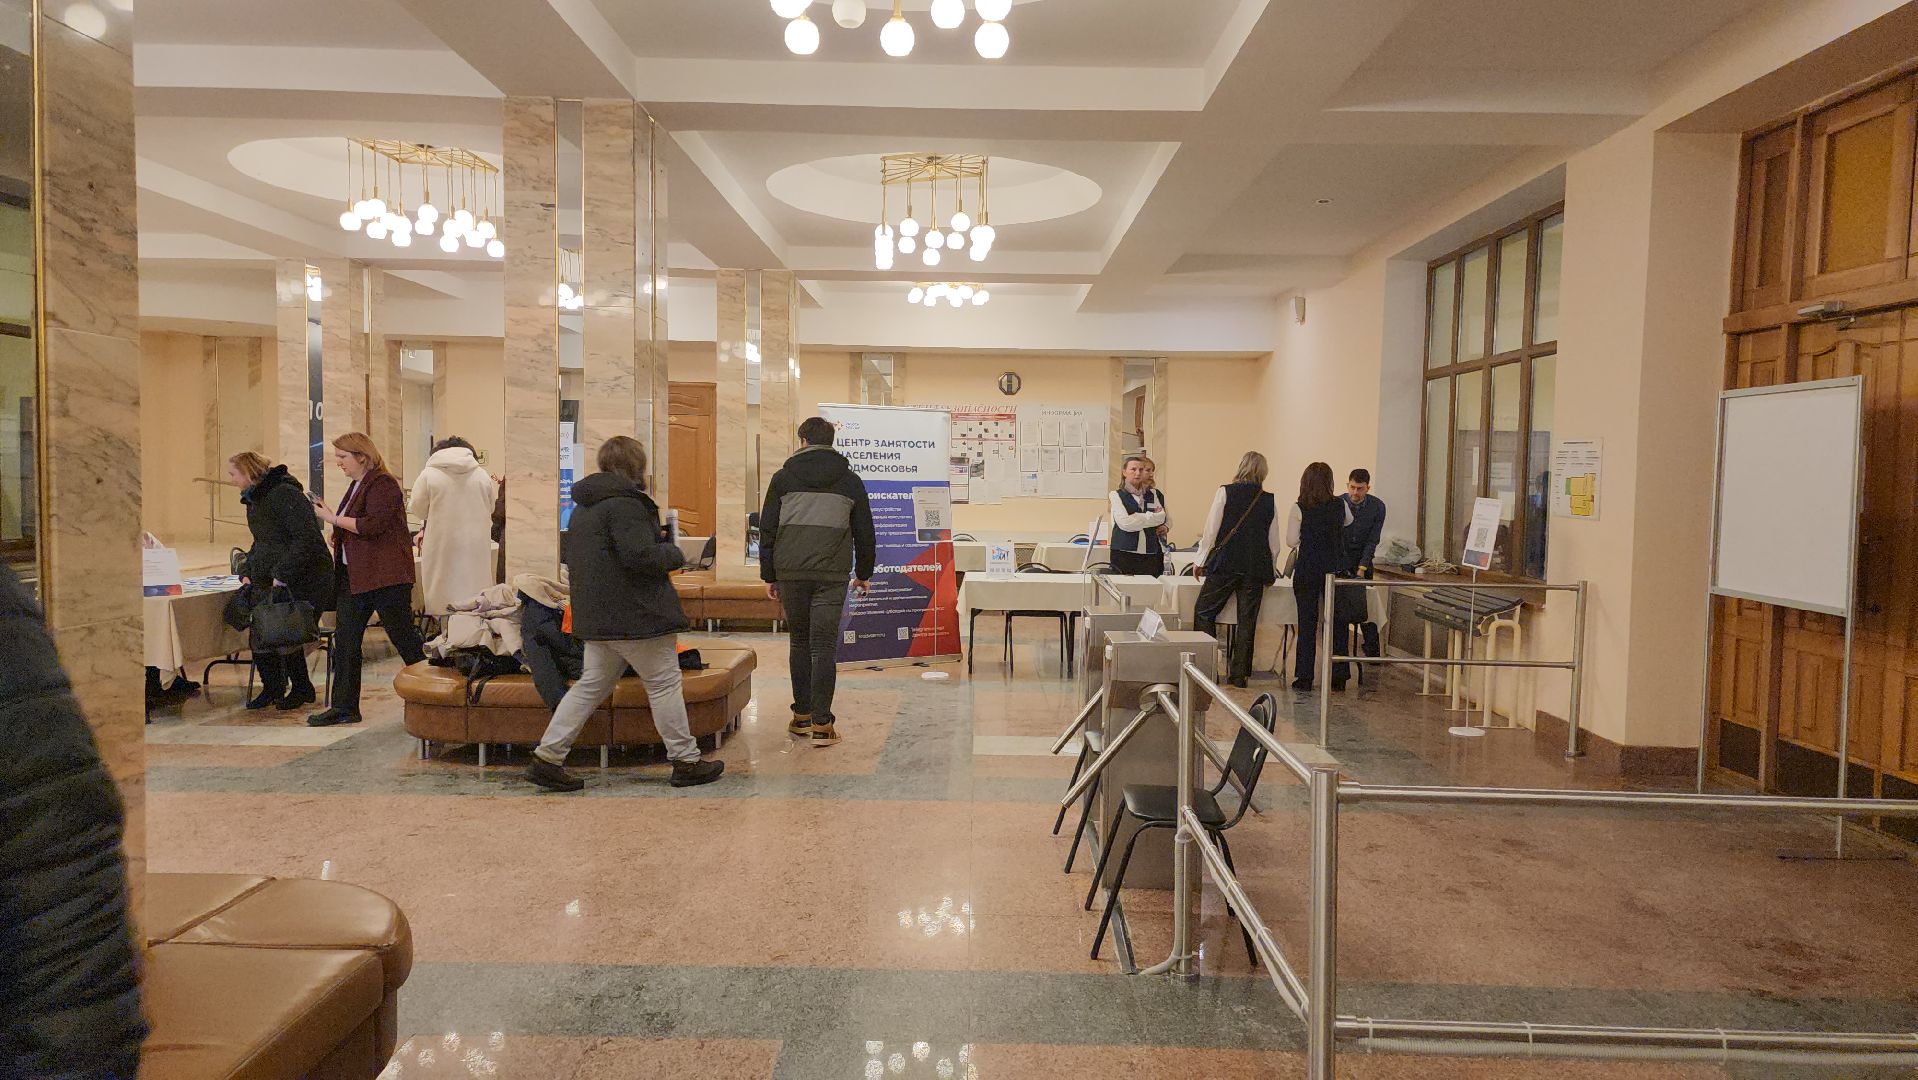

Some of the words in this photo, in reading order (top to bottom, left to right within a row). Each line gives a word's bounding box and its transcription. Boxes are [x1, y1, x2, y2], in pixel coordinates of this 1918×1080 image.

[836, 438, 871, 448] ЦЕНТР
[873, 440, 936, 449] ЗАНЯТОСТИ
[848, 464, 918, 474] ОДМОСКОВЬЯ
